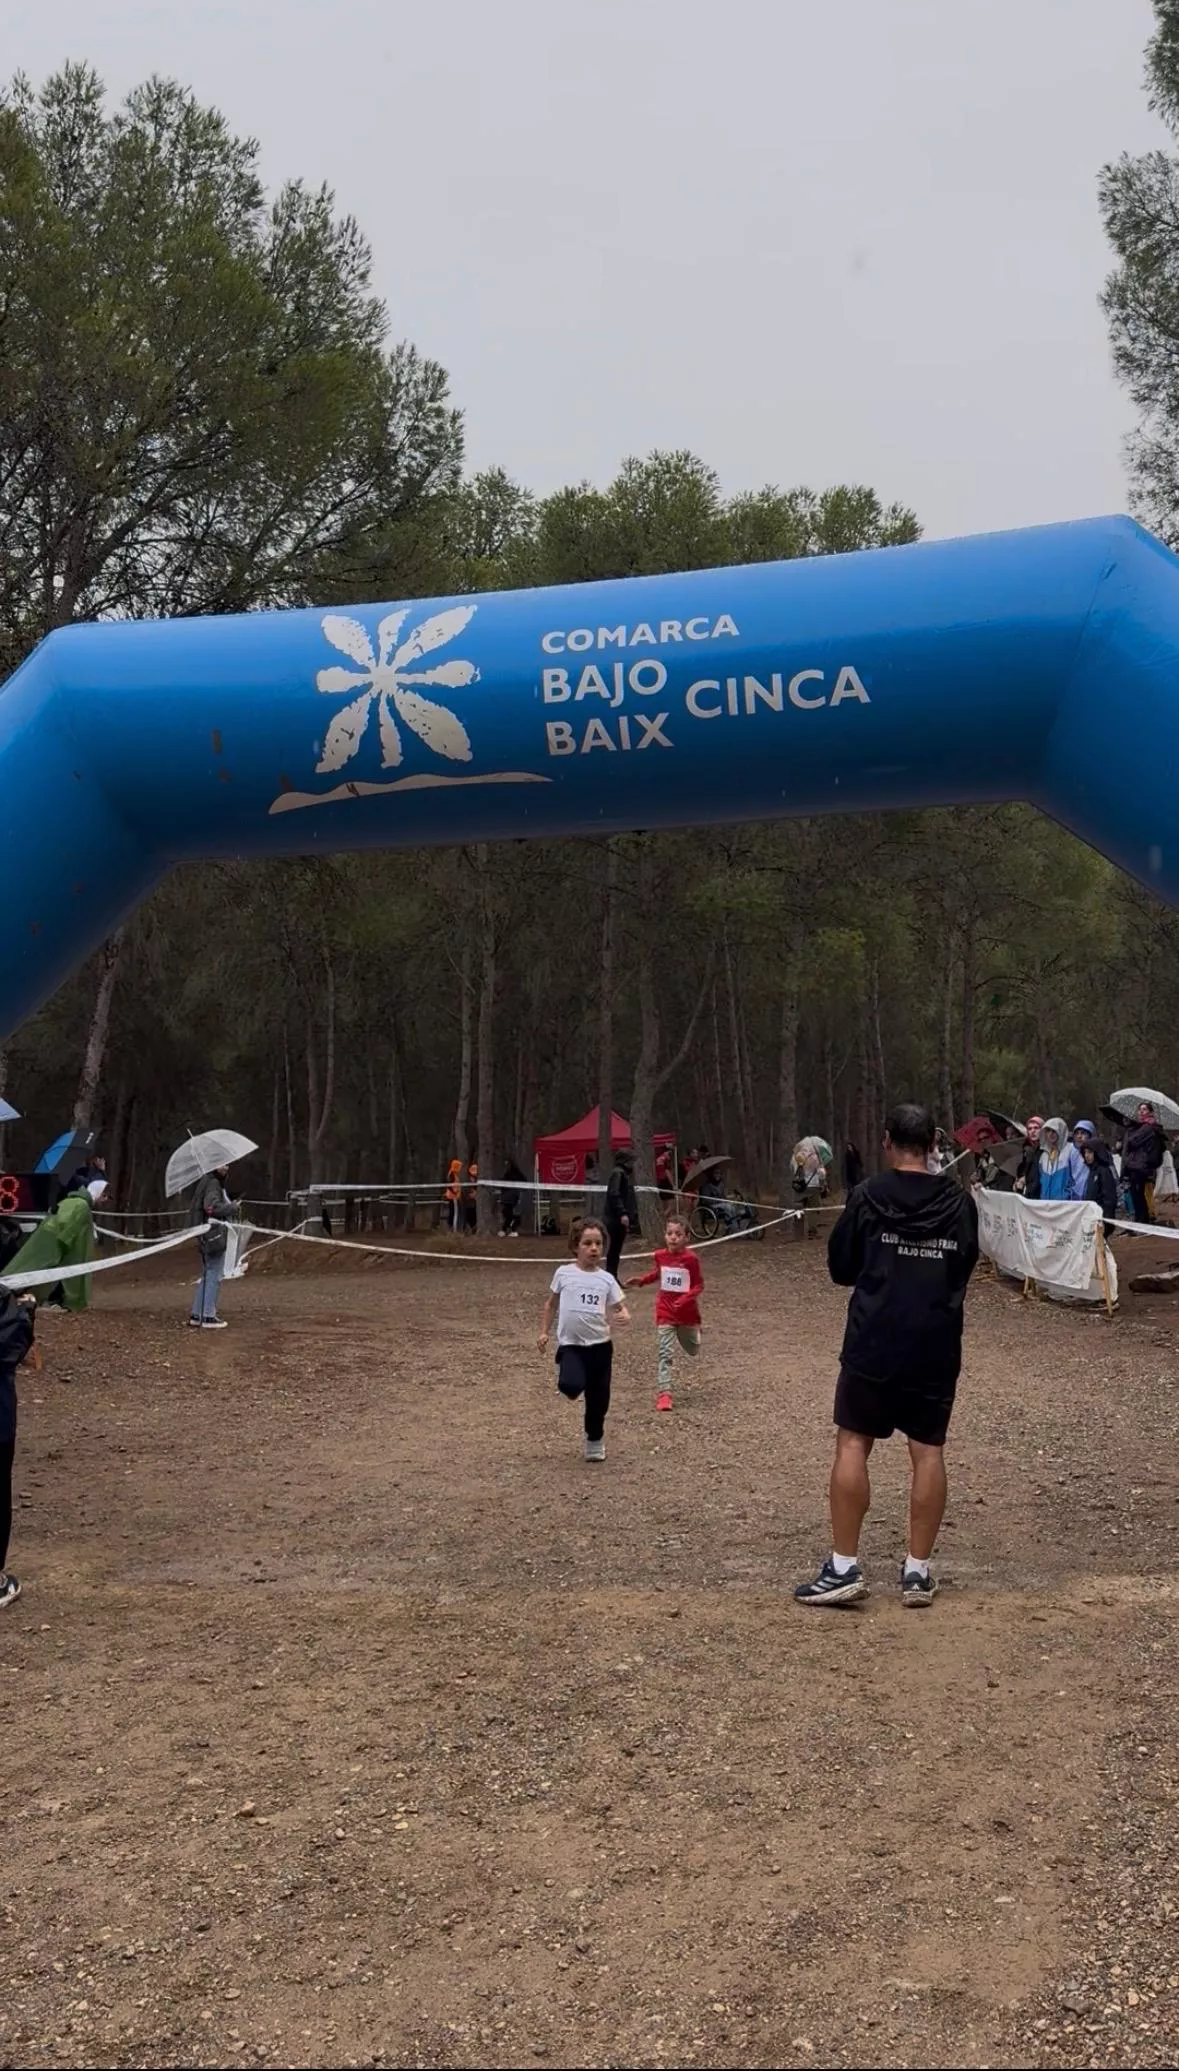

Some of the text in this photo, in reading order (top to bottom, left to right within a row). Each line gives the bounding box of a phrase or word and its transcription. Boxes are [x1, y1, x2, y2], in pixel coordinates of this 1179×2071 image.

[542, 614, 740, 654] COMARCA
[543, 659, 667, 708] BAJO
[686, 665, 871, 719] CINCA
[546, 712, 674, 756] BAIX
[882, 1233, 899, 1244] CLUB
[898, 1247, 943, 1259] BAJO CINCA
[580, 1294, 599, 1305] 132
